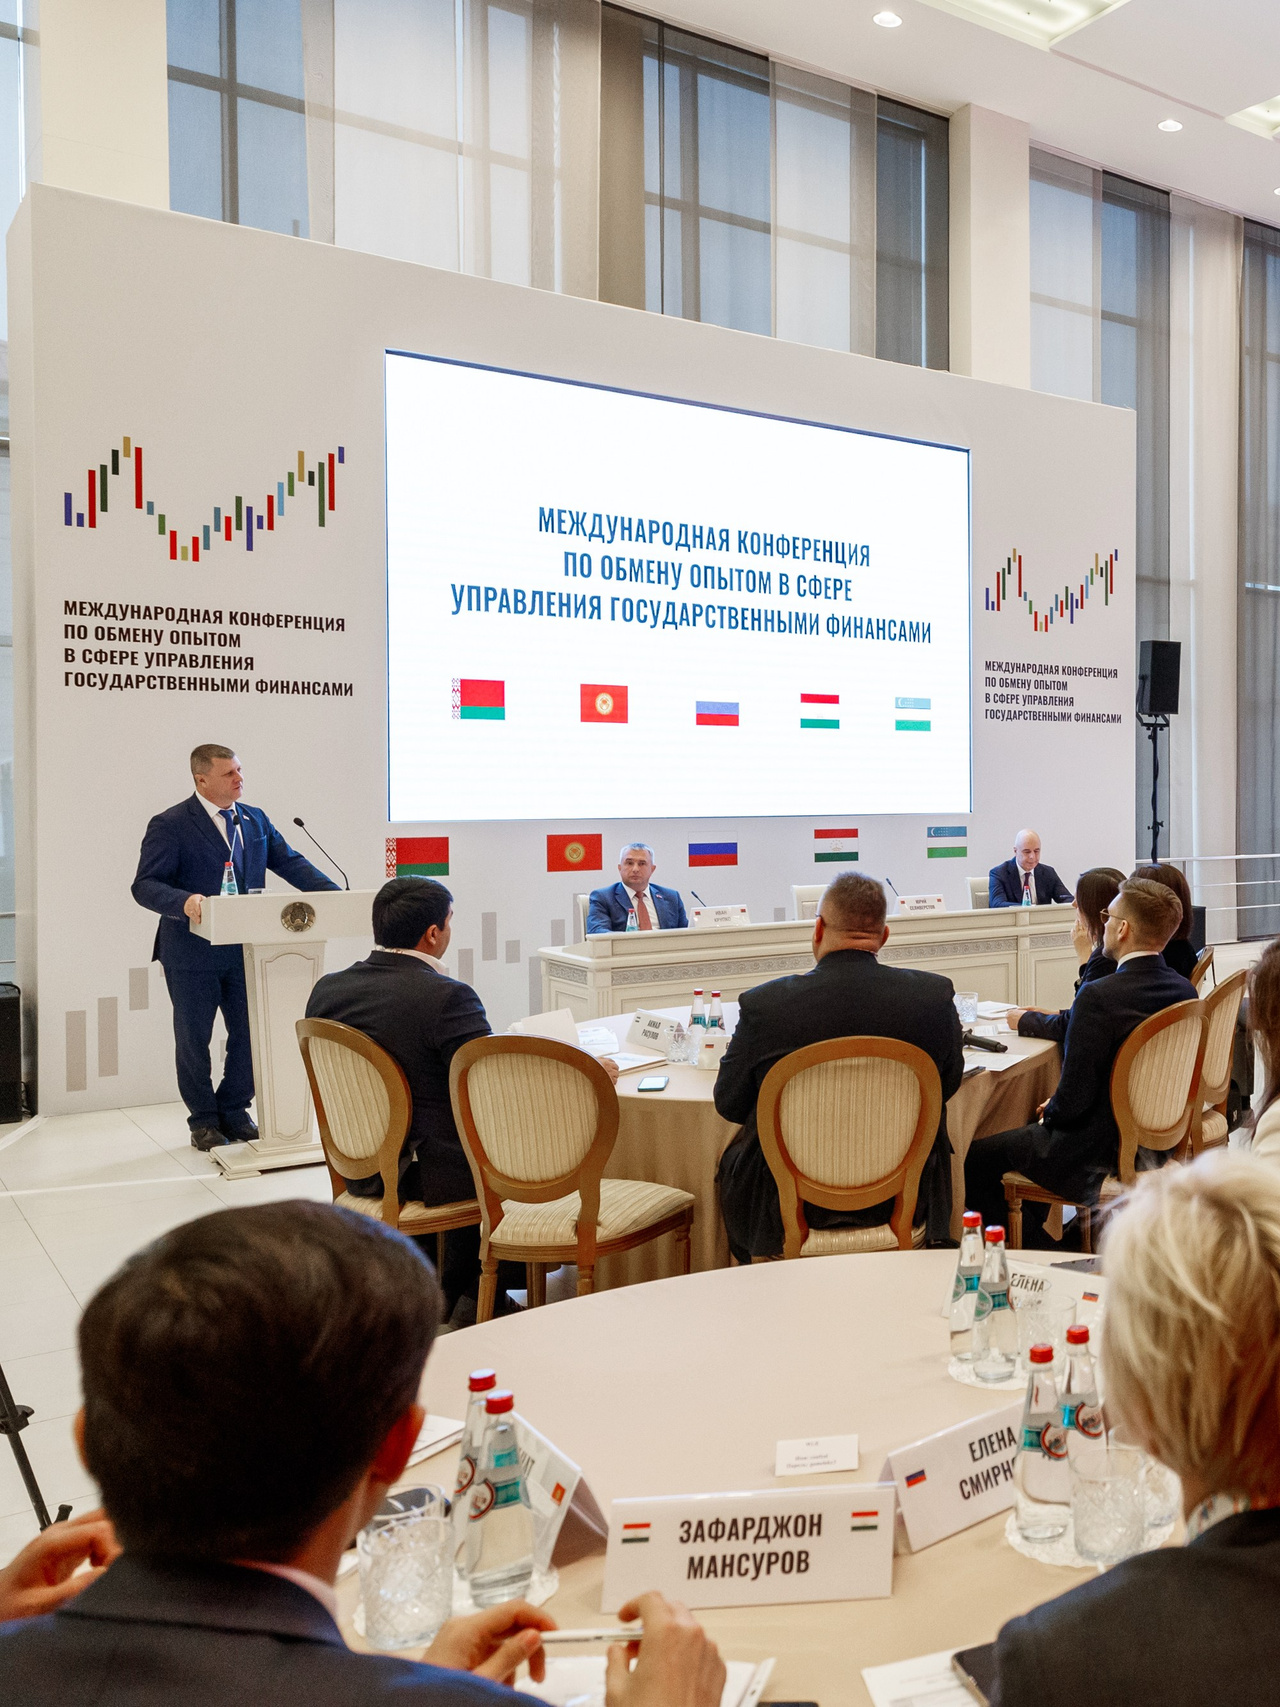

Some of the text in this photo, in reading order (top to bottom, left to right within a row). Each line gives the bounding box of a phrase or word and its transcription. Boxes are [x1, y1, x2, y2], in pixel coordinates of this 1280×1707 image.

[538, 505, 871, 568] МЕЖДУНАРОДНАЯ КОНФЕРЕНЦИЯ
[563, 551, 853, 602] ПО ОБМЕНУ ОПЫТОМ В СФЕРЕ
[64, 600, 346, 633] МЕЖДУНАРОДНАЯ КОНФЕРЕНЦИЯ
[451, 582, 932, 644] УПРАВЛЕНИЯ ГОСУДАРСТВЕННЫМИ ФИНАНСАМИ
[64, 624, 241, 648] ПО ОБМЕНУ ОПЫТОМ
[64, 648, 255, 671] В СФЕРЕ УПРАВЛЕНИЯ
[985, 660, 1118, 680] МЕЖДУНАРОДНАЯ КОНФЕРЕНЦИЯ
[64, 671, 353, 697] ГОСУДАРСТВЕННЫМИ ФИНАНСАМИ
[985, 677, 1068, 691] ПО ОБМЕНУ ОПЫТОМ
[985, 693, 1075, 707] В СФЕРЕ УПРАВЛЕНИЯ
[985, 708, 1122, 724] ГОСУДАРСТВЕННЫМИ ФИНАНСАМИ
[641, 1028, 659, 1040] РАСУЛОВ
[1010, 1273, 1044, 1293] ЕЛЕНА
[968, 1426, 1017, 1462] ЕЛЕНА
[679, 1513, 823, 1544] ЗАФАРДЖОН
[686, 1549, 810, 1580] МАНСУРОВ
